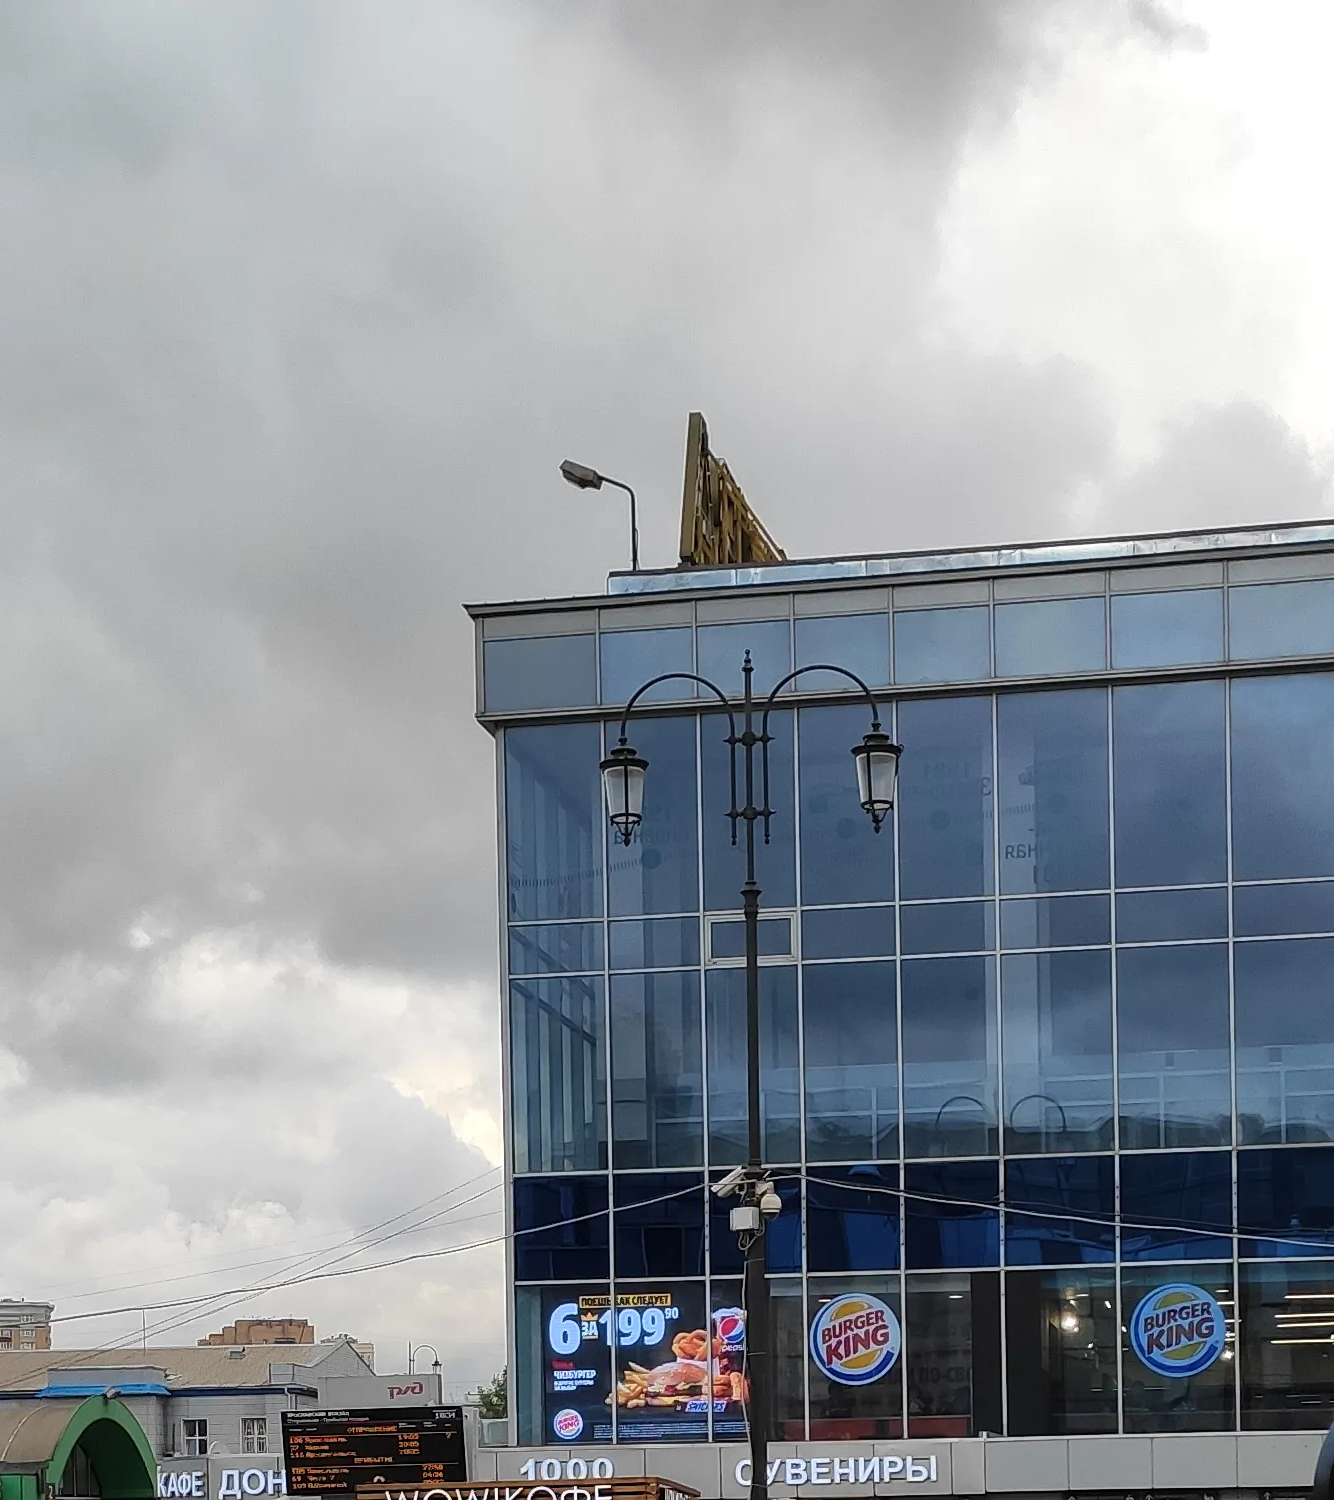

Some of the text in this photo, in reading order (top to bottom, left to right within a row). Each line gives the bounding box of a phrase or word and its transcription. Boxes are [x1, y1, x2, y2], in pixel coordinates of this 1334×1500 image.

[632, 1296, 668, 1305] СЛЕДУЕТ
[549, 1303, 581, 1355] 6
[822, 1309, 886, 1344] BURGER
[1144, 1302, 1211, 1334] BURGER
[825, 1324, 889, 1367] KING
[1147, 1317, 1214, 1355] KING
[157, 1464, 205, 1498] КАФЕ
[519, 1456, 614, 1480] 1000
[734, 1454, 938, 1486] СУВЕНИРЫ
